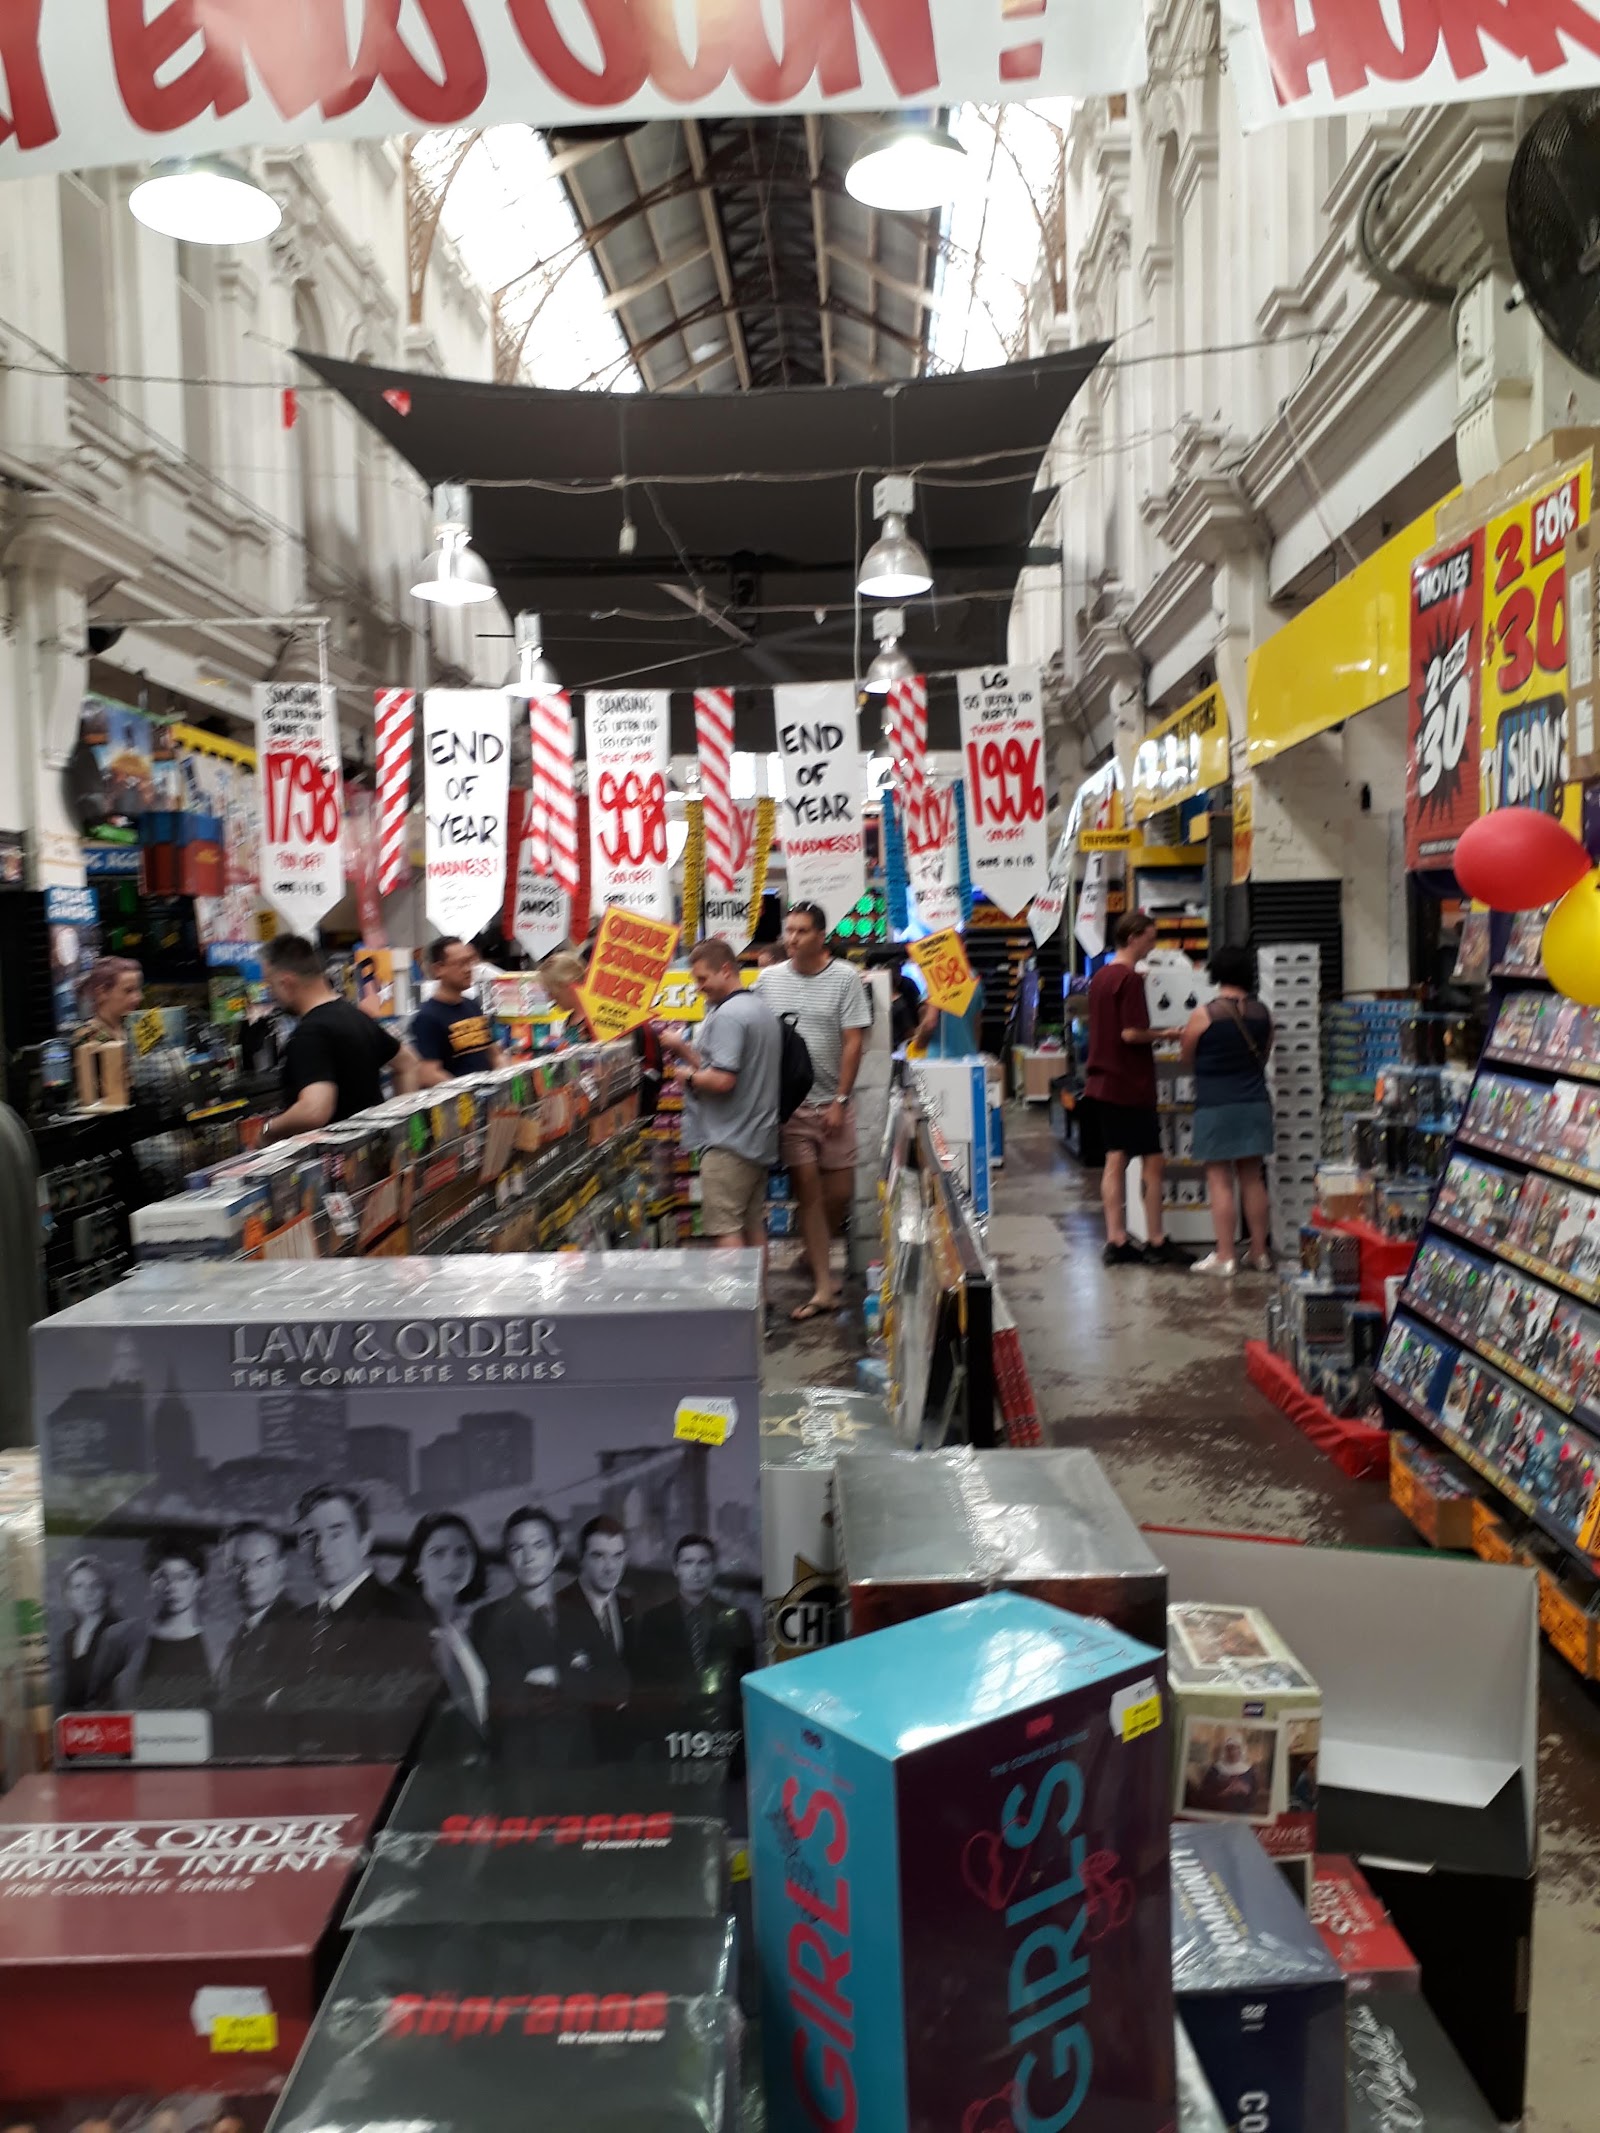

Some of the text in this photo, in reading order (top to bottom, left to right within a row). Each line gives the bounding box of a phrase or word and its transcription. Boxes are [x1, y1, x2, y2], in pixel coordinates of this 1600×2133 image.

[1495, 483, 1576, 595] 2 FOR
[1418, 552, 1470, 608] MOVIES
[981, 672, 1008, 689] LG
[1424, 654, 1442, 717] 2
[428, 729, 504, 766] END
[779, 721, 844, 753] END
[446, 776, 479, 801] OF
[795, 762, 830, 785] OF
[264, 752, 341, 842] 1798
[784, 794, 853, 827] YEAR
[428, 814, 498, 847] YEAR
[231, 1318, 562, 1363] LAW & ORDER
[230, 1361, 567, 1387] THE COMPLETE SERIES
[664, 1731, 713, 1758] 119
[100, 1827, 148, 1850] &
[154, 1821, 346, 1851] ORDER
[177, 1850, 335, 1875] INTENT
[51, 1877, 175, 1896] COMPLETE
[176, 1875, 256, 1893] SERIES
[782, 1775, 857, 2133] GIRLS
[1001, 1760, 1093, 2132] GIRLS
